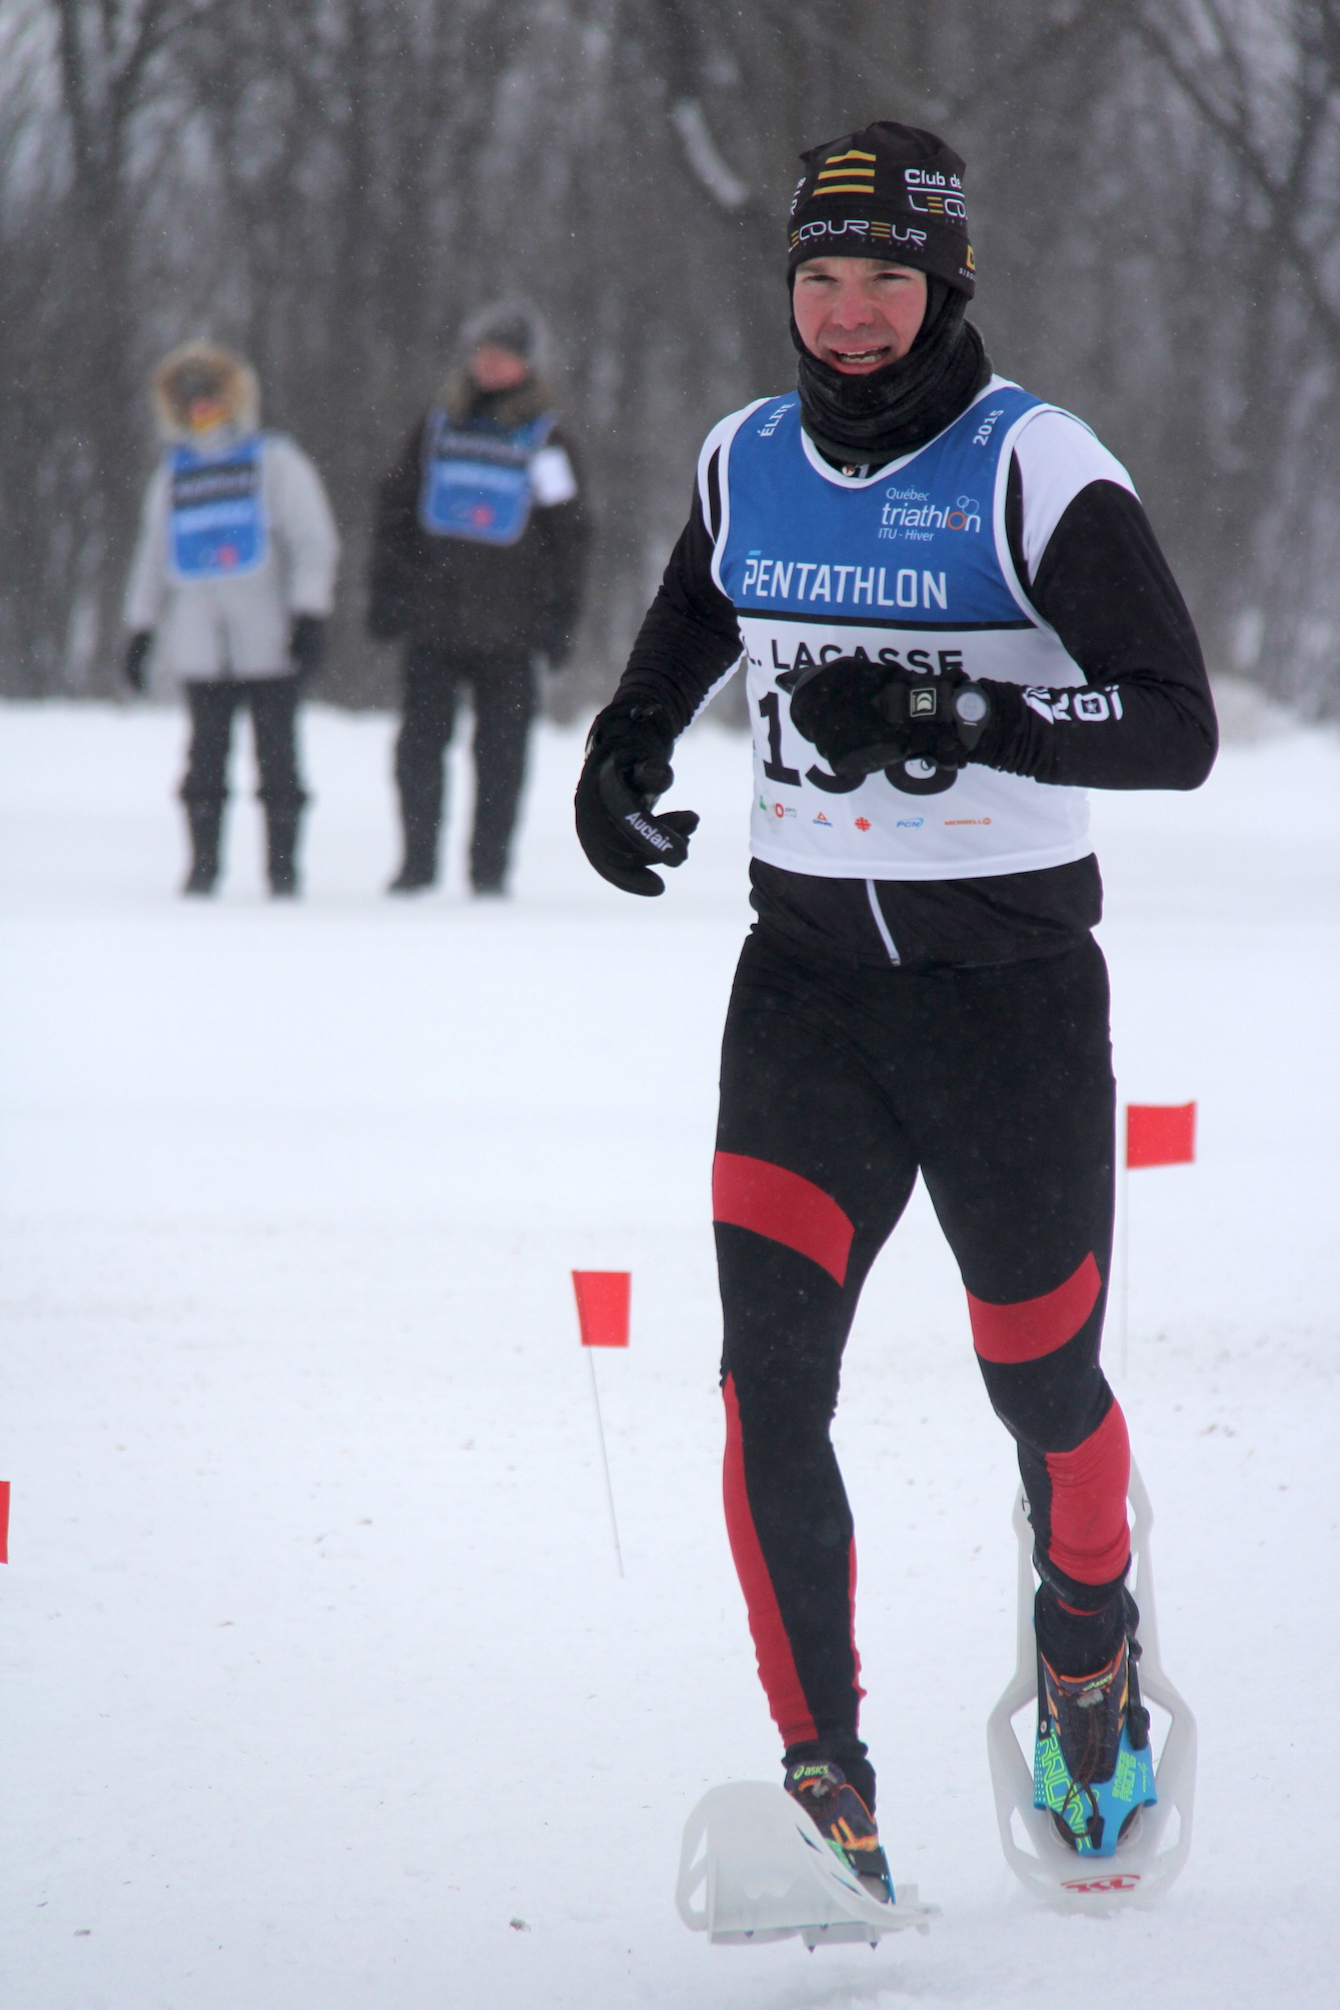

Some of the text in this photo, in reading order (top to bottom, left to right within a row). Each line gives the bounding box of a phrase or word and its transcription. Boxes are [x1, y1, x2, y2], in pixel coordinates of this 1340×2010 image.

[904, 168, 946, 186] Club
[908, 194, 967, 219] LECO
[757, 402, 796, 438] ÉLITE
[973, 408, 1004, 446] 2015
[886, 487, 930, 502] Québec
[881, 502, 981, 533] triathlon
[878, 527, 898, 540] ITU
[905, 529, 935, 541] Hiver
[742, 558, 948, 610] PENTATHLON
[624, 811, 674, 852] Auclair
